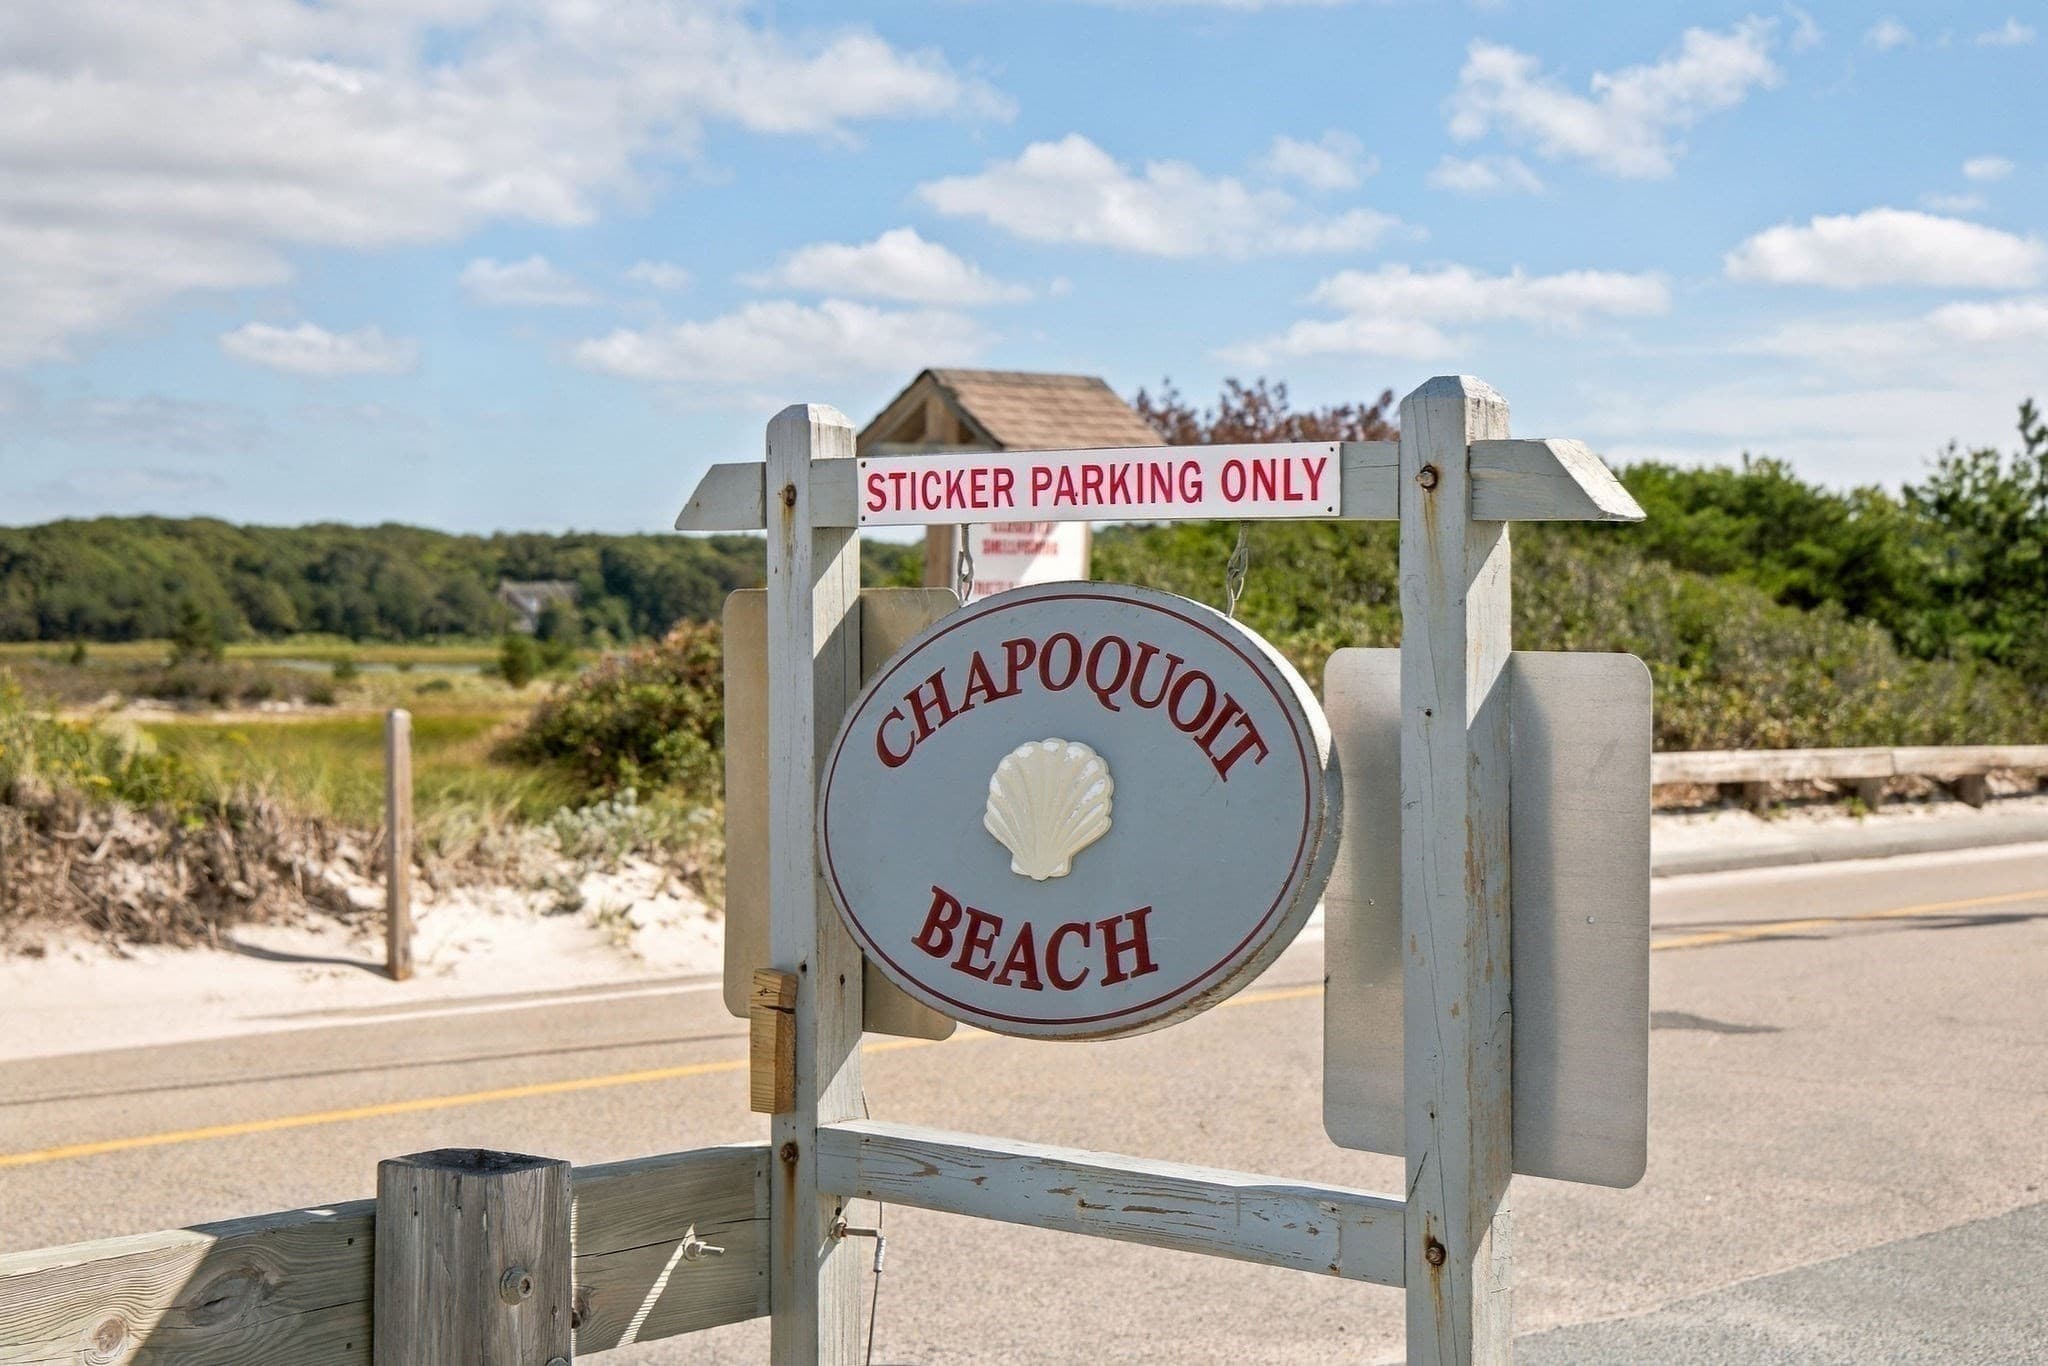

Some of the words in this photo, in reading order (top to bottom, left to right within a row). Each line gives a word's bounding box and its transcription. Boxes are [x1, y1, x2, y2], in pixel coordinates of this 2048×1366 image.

[866, 467, 1014, 512] STICKER
[1032, 460, 1202, 506] PARKING
[1221, 457, 1327, 502] ONLY
[875, 632, 1269, 782] CHAPOQUOIT
[911, 885, 1159, 992] BEACH
